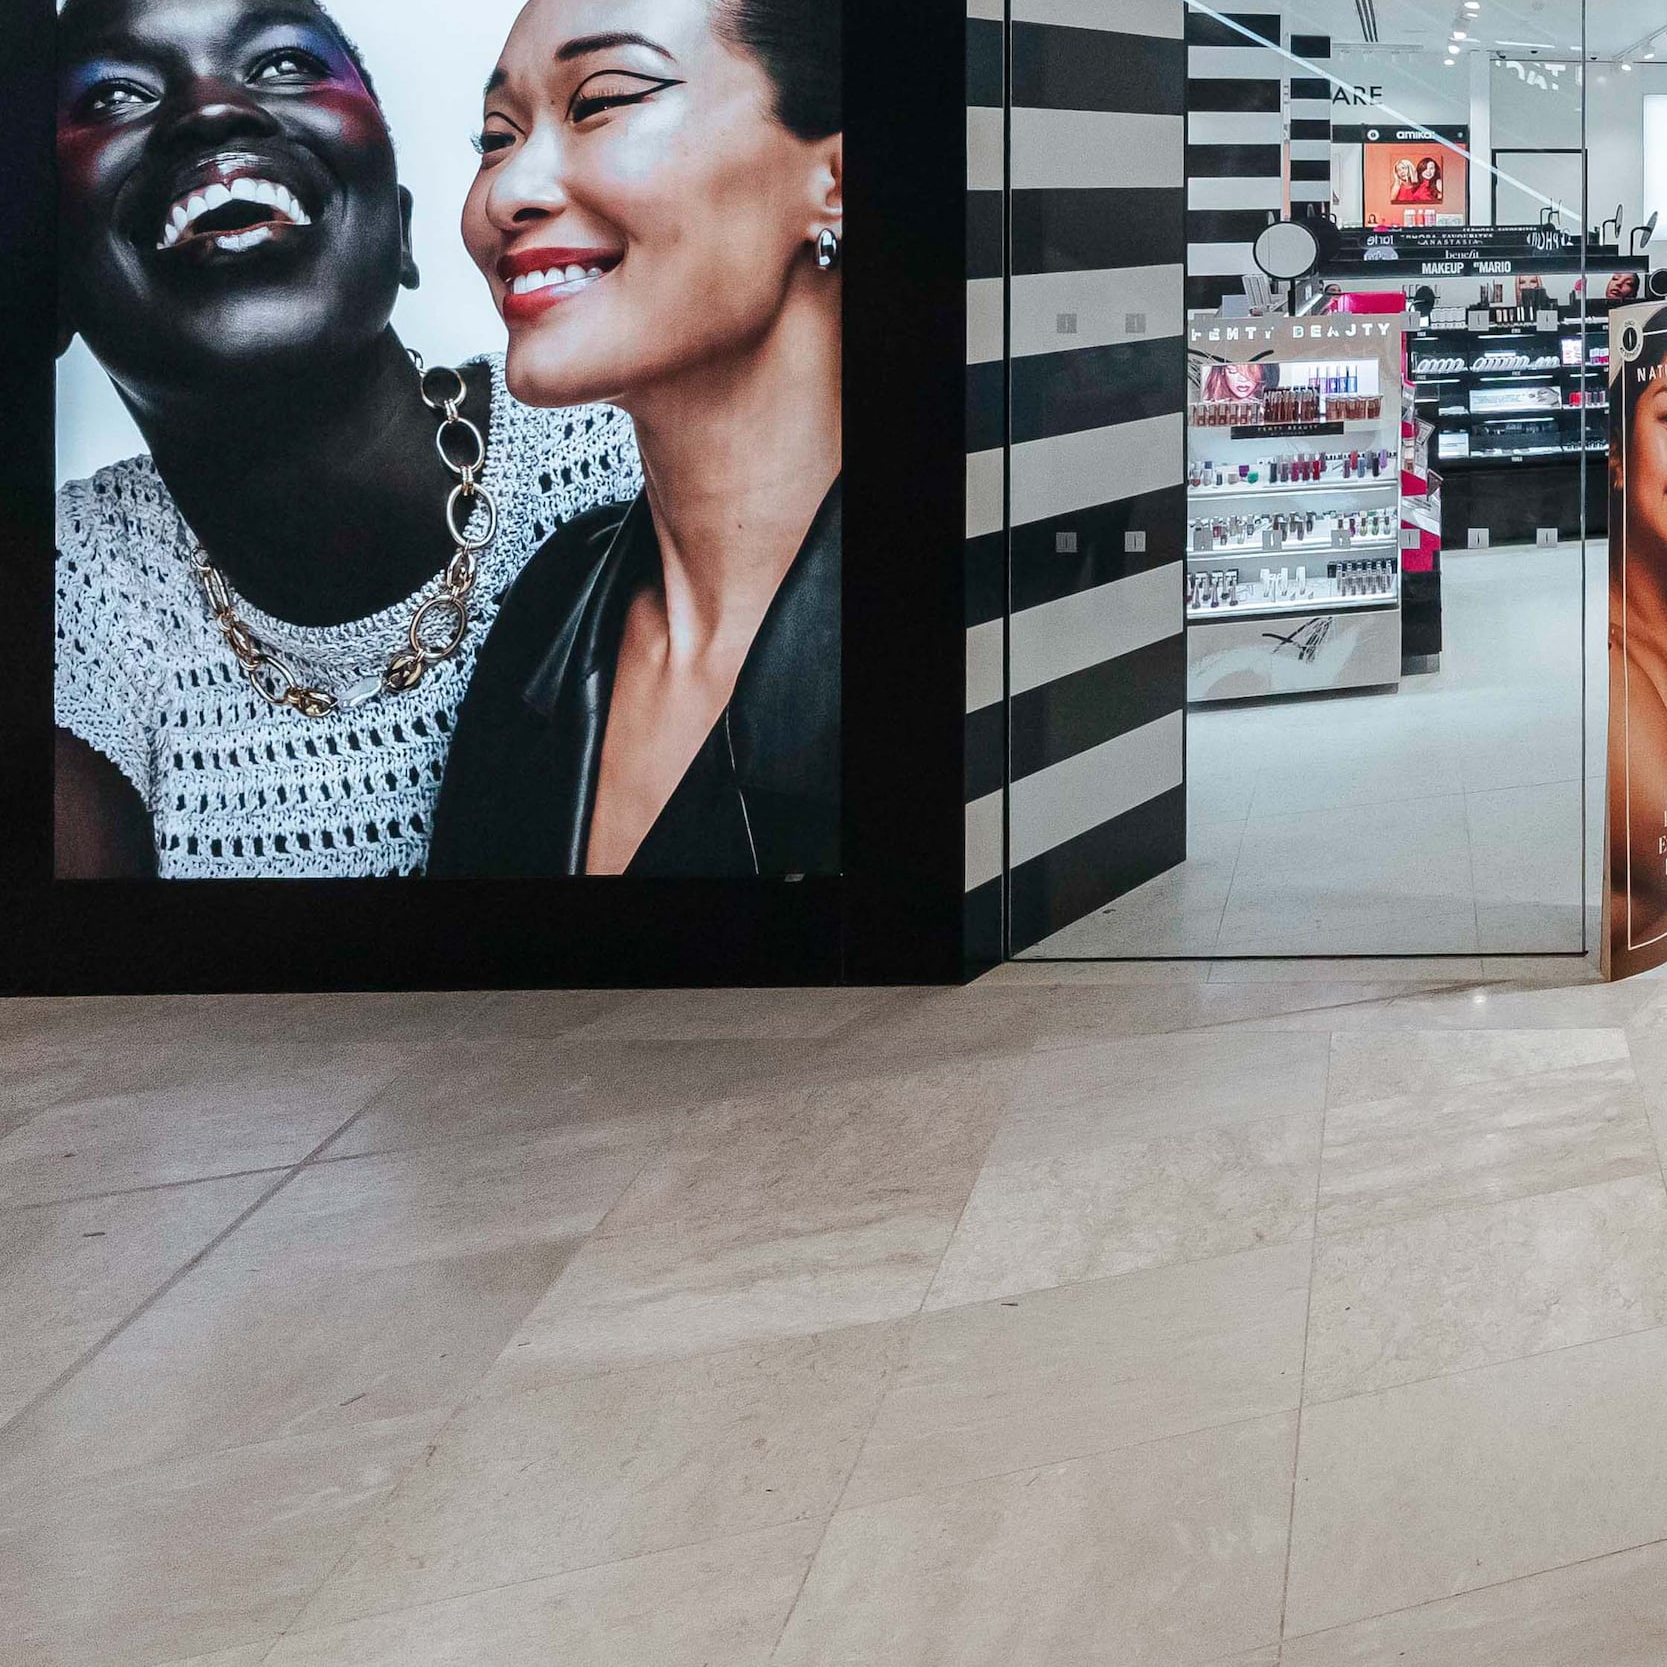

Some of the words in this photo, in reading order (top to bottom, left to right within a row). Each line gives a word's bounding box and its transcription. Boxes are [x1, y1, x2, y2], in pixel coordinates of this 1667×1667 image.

[1422, 262, 1465, 274] MAKEUP
[1479, 261, 1511, 273] MARIO
[1190, 326, 1275, 342] FENTY
[1292, 322, 1391, 338] BEAUTY
